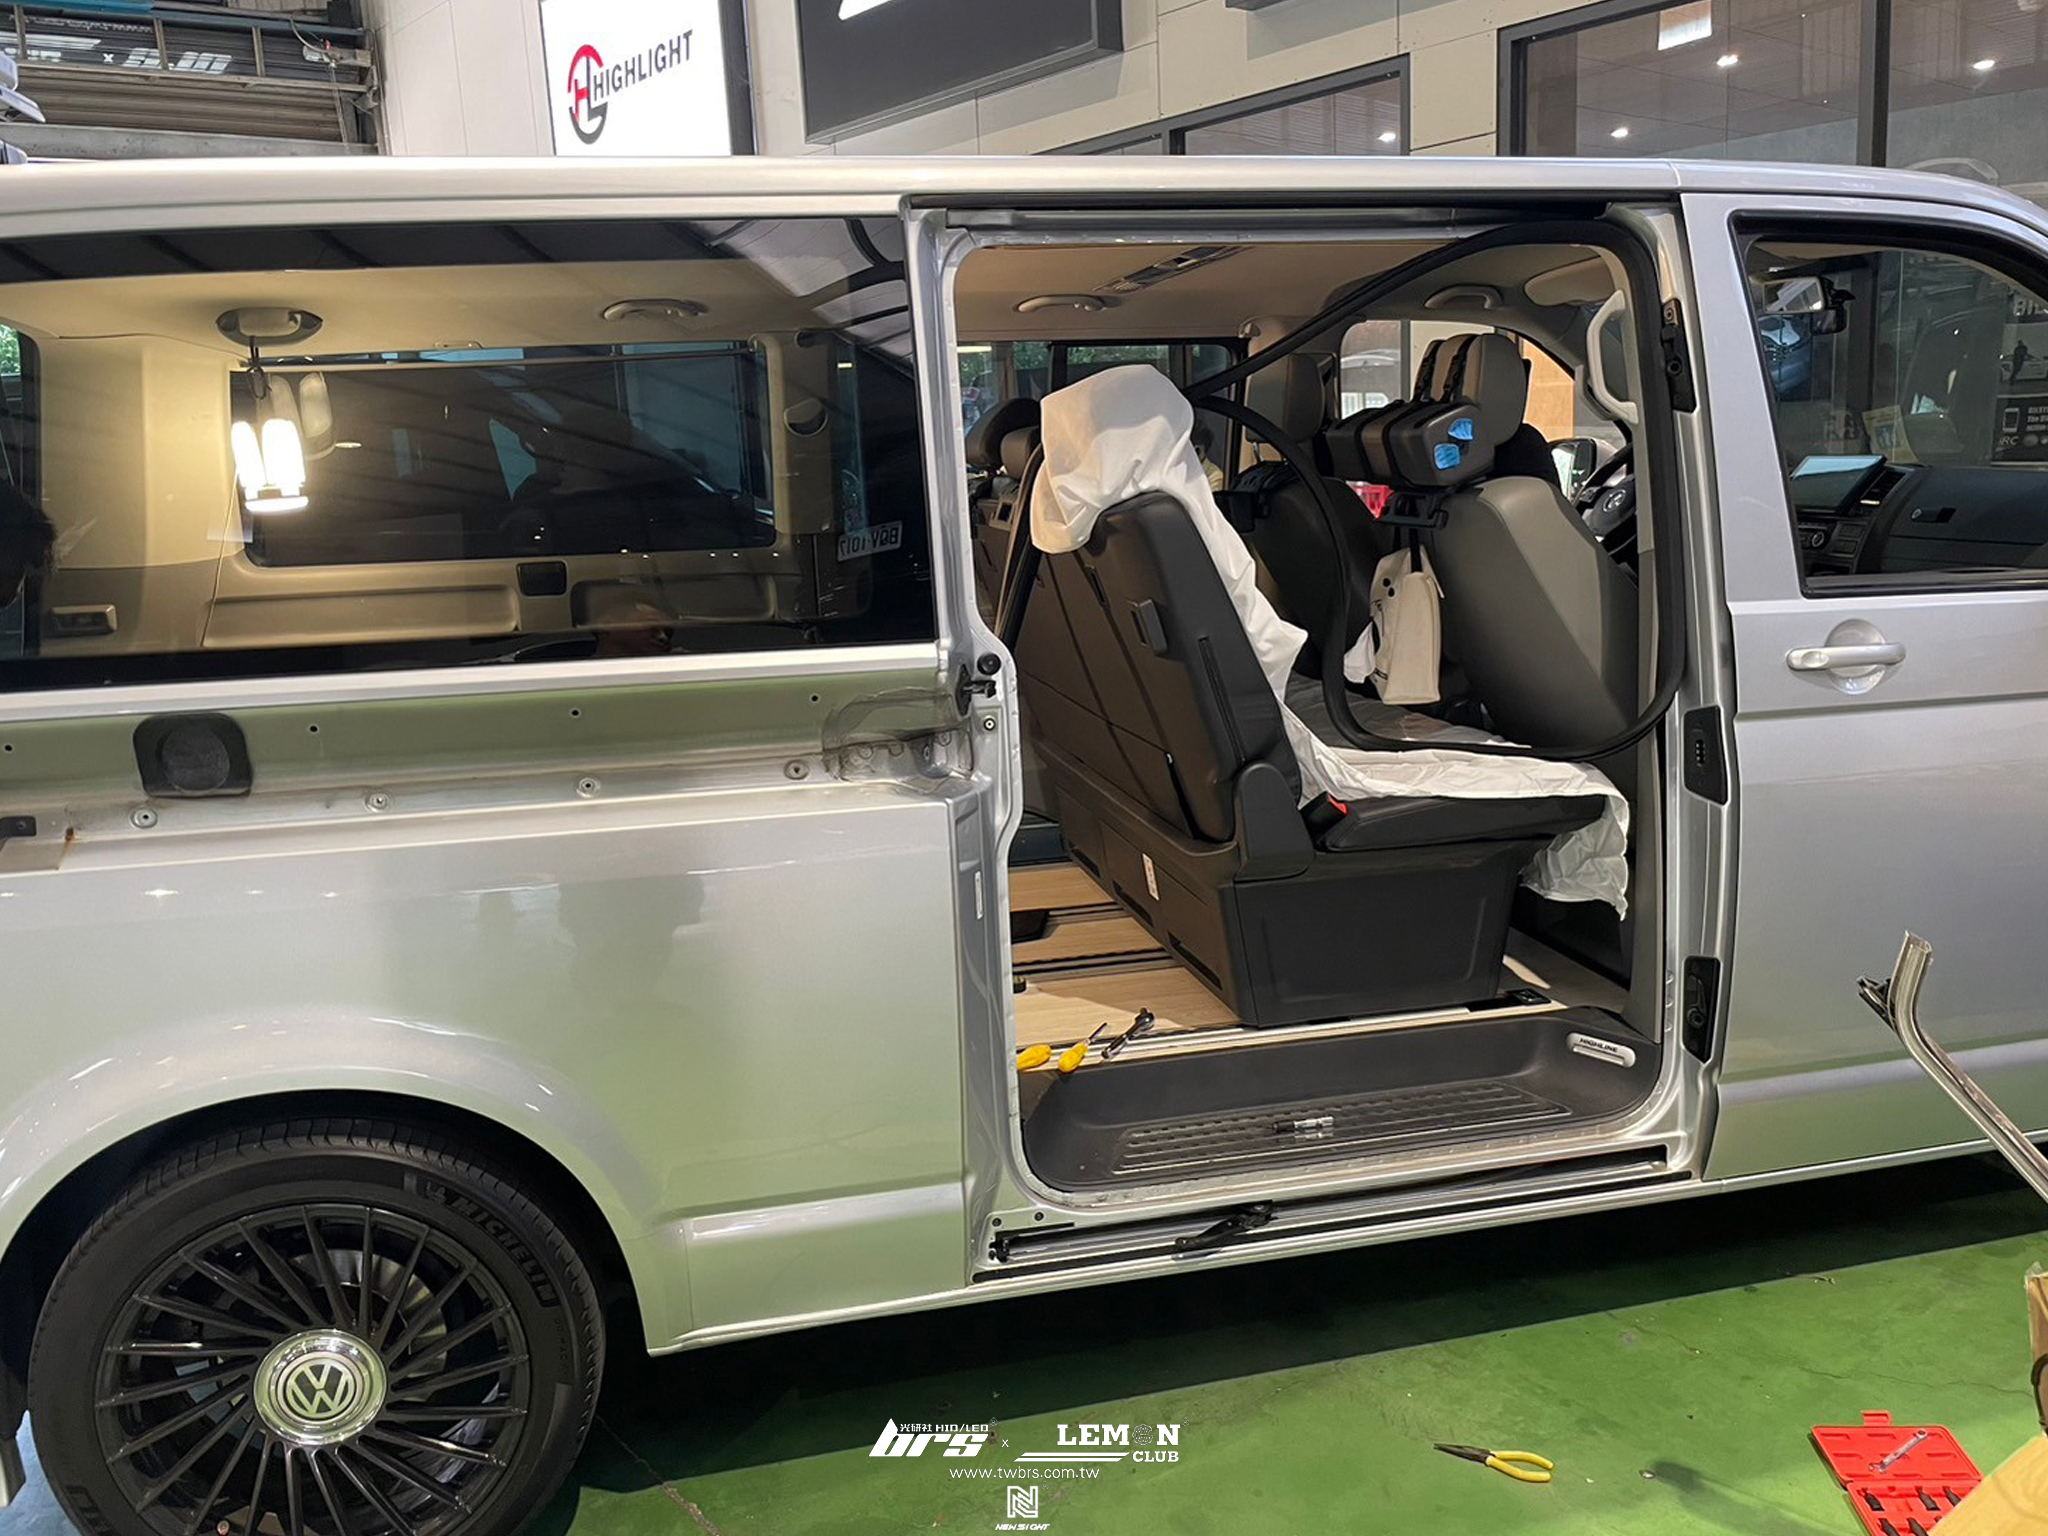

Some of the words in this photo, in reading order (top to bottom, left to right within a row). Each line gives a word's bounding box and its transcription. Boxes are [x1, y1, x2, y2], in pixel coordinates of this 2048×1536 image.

[594, 29, 693, 101] HIGHLIGHT
[1579, 1038, 1618, 1052] HIGHLINE
[450, 1197, 557, 1303] MICHELIN
